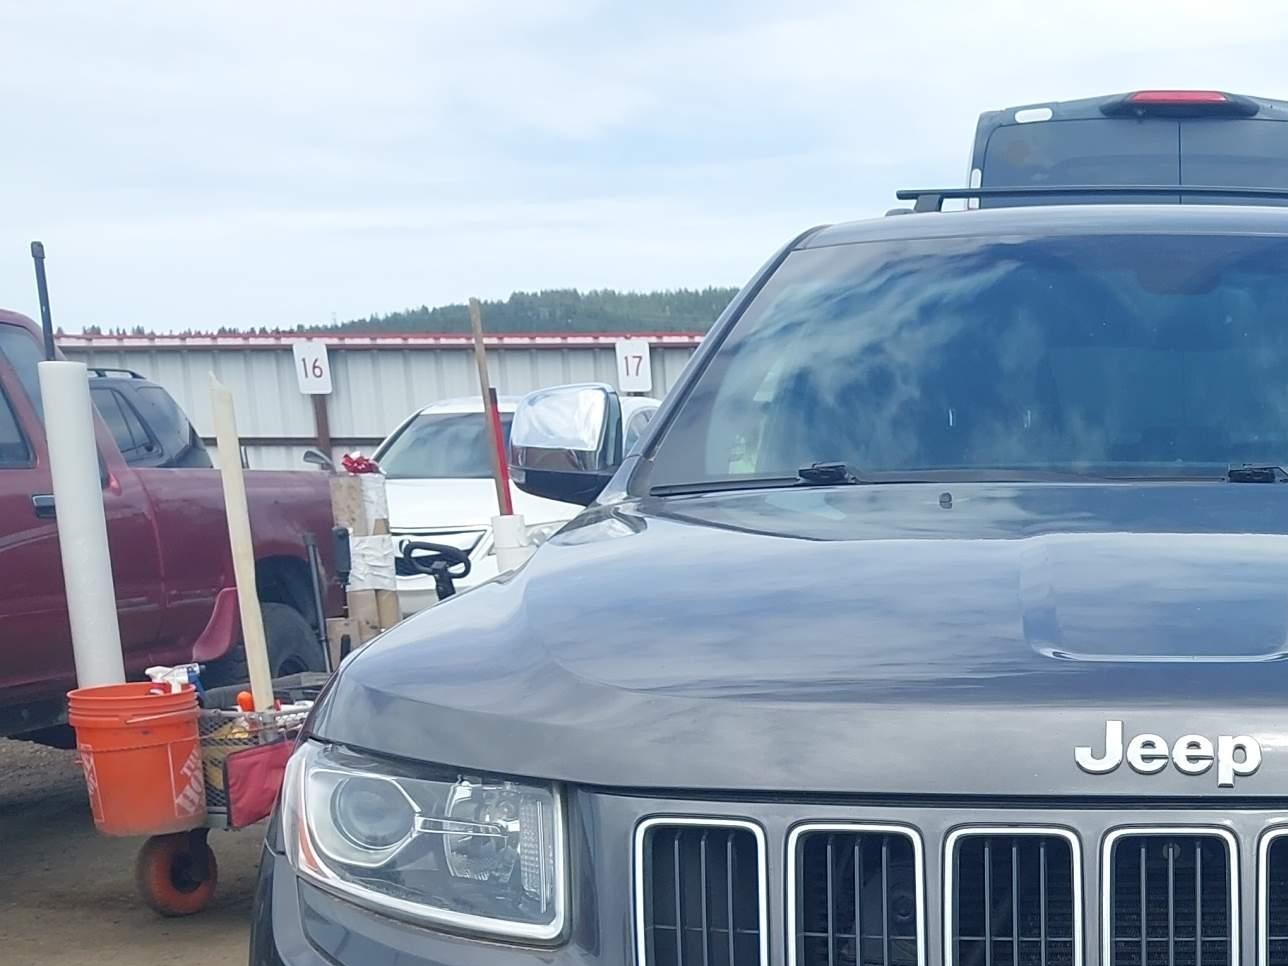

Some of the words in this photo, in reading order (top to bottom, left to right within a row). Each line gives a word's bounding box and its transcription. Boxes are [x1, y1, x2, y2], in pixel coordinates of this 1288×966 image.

[301, 356, 324, 379] 16
[623, 354, 643, 377] 17
[1074, 719, 1262, 789] Jeep
